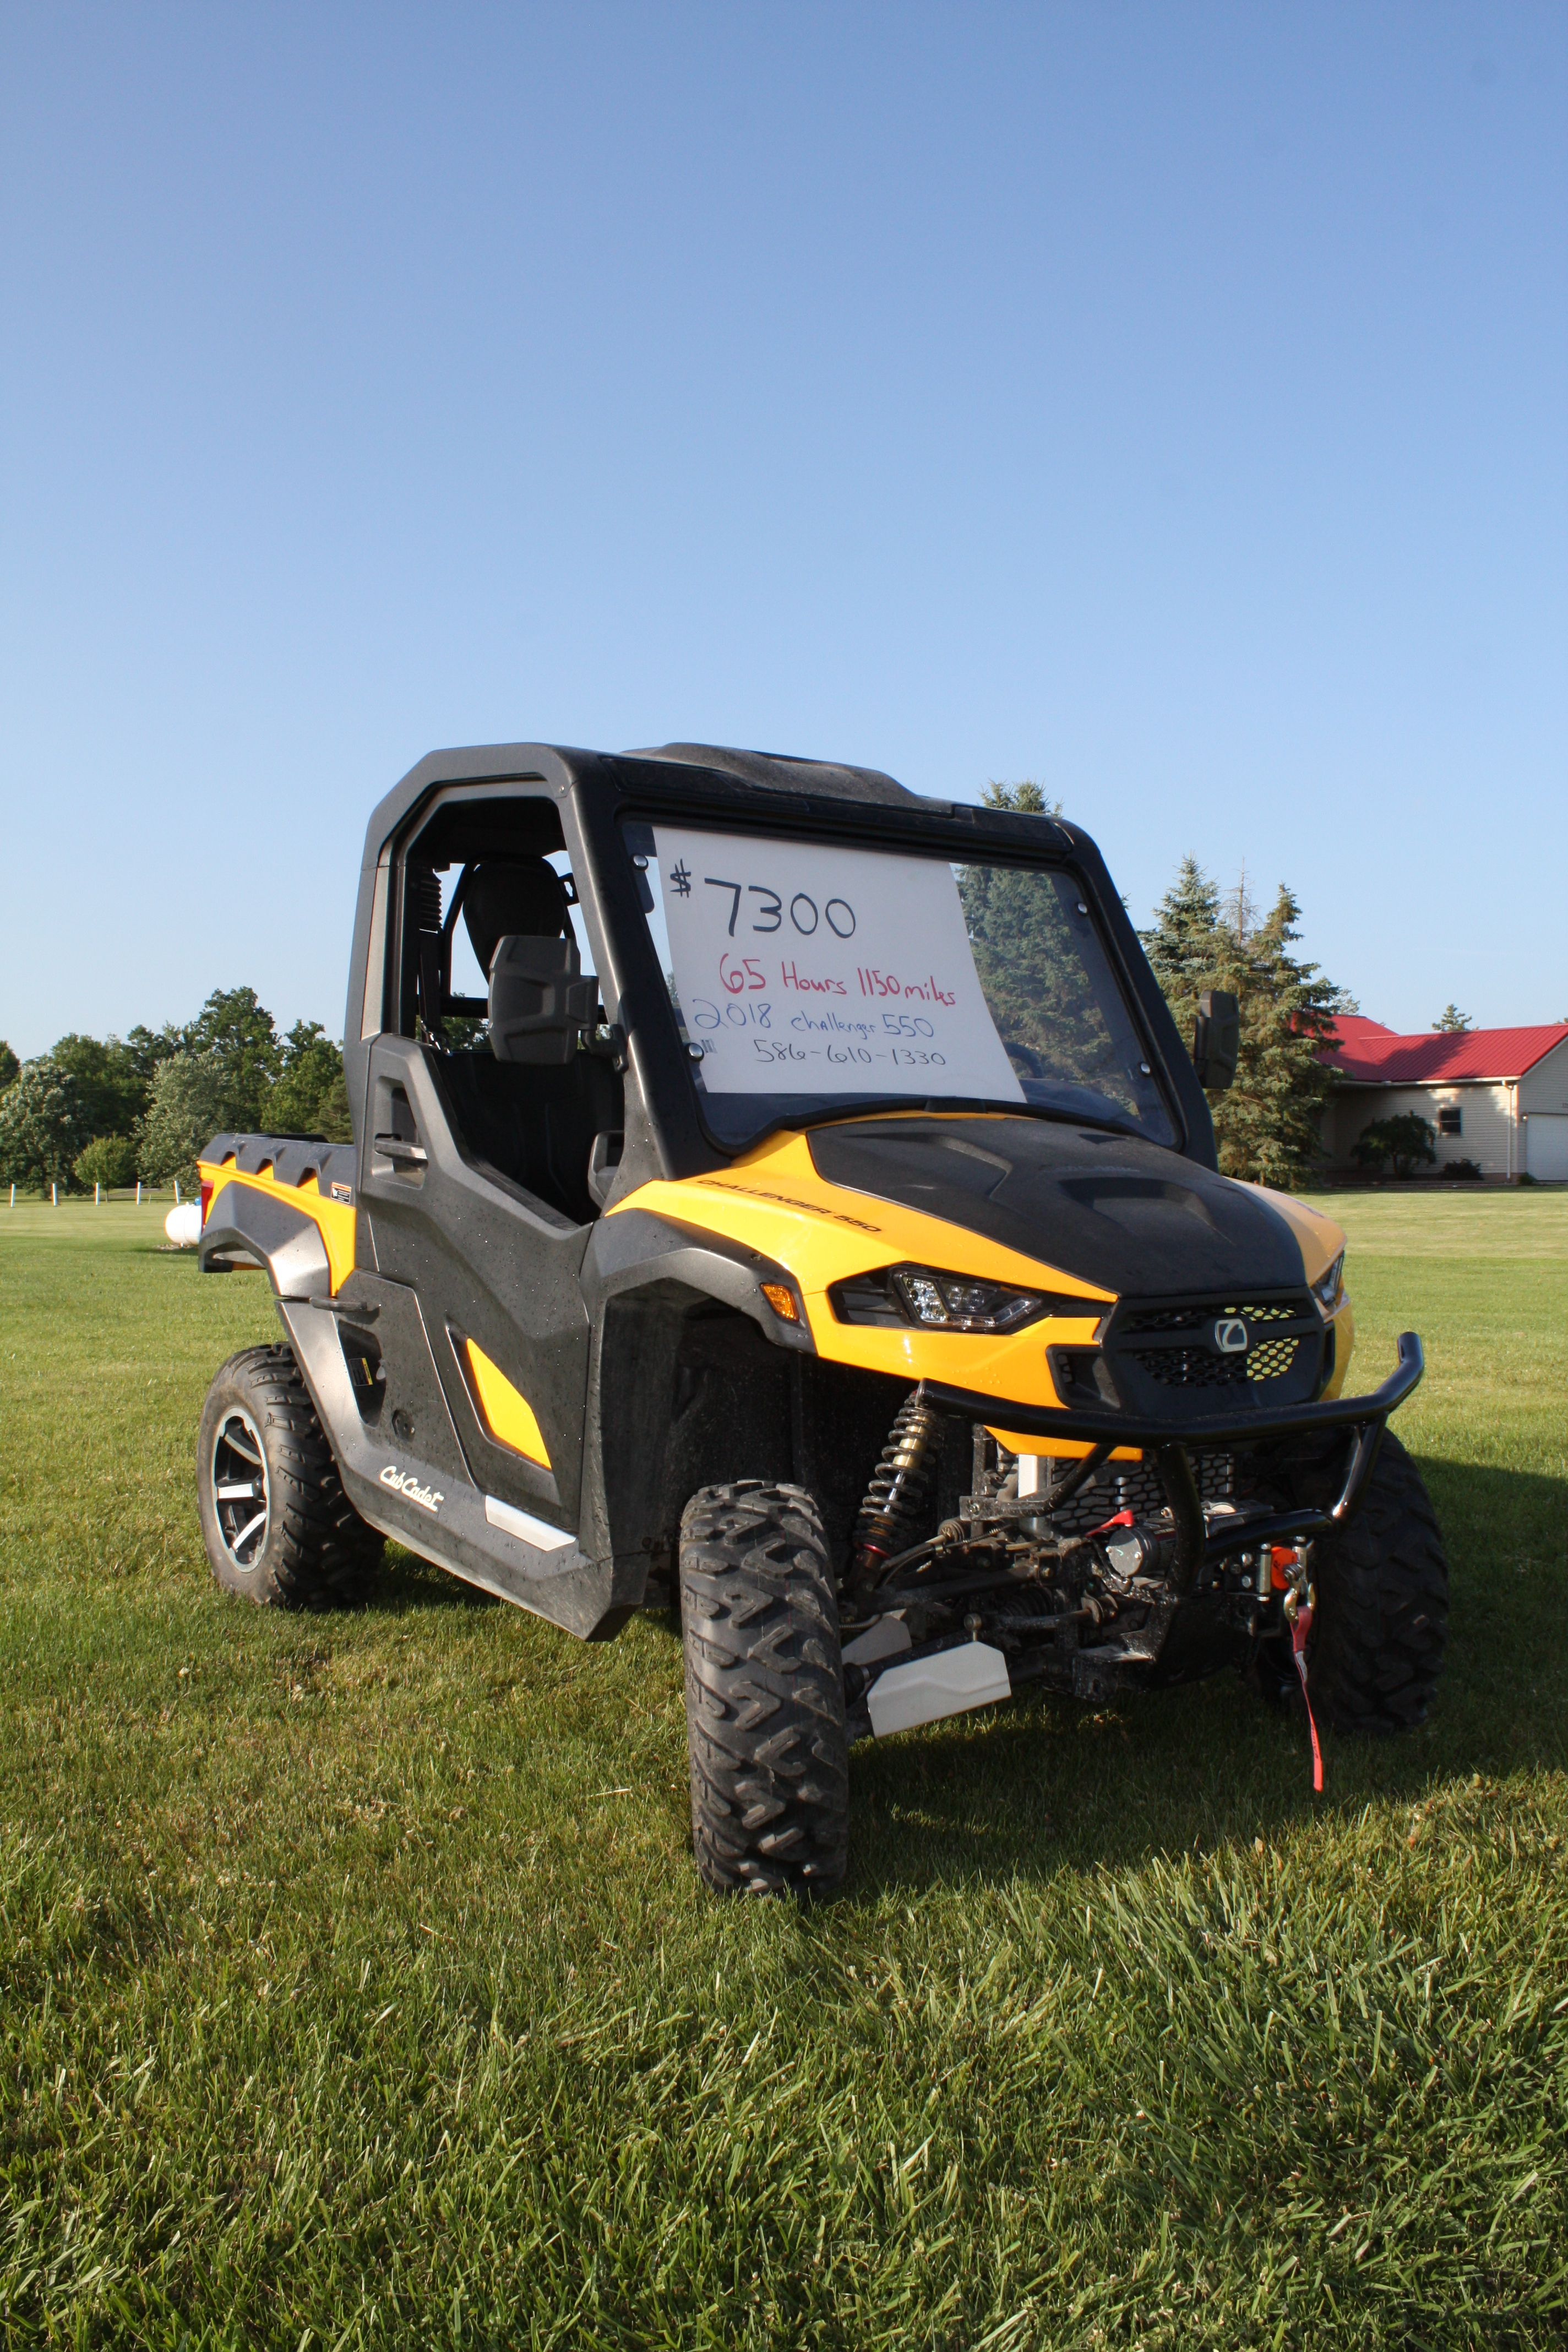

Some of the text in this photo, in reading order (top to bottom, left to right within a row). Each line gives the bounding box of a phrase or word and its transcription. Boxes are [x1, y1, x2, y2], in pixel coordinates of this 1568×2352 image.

[670, 858, 857, 939] $ 7300
[719, 953, 766, 994] 65
[781, 961, 847, 995] Hours
[904, 975, 956, 1007] miles
[692, 998, 772, 1030] 2018
[881, 1014, 934, 1038] 550
[753, 1038, 946, 1066] 586-610-1330
[696, 1179, 882, 1232] CHALLENGER 550
